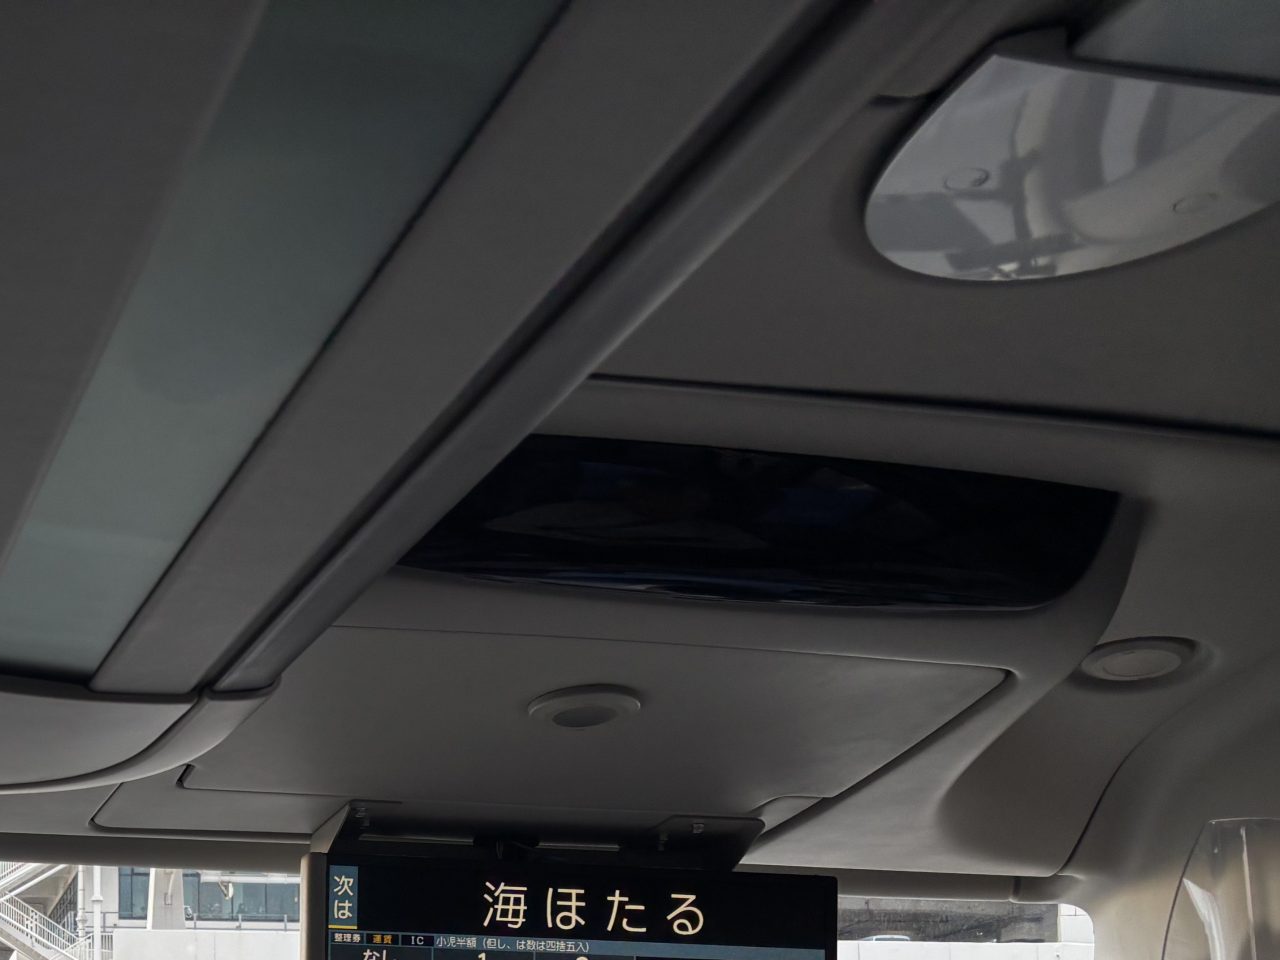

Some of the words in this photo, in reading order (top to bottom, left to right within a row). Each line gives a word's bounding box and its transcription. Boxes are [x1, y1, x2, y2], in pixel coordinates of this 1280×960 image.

[333, 875, 354, 919] 次は
[483, 881, 704, 934] 海ほたる
[334, 933, 361, 943] 整理券
[411, 936, 424, 945] IC
